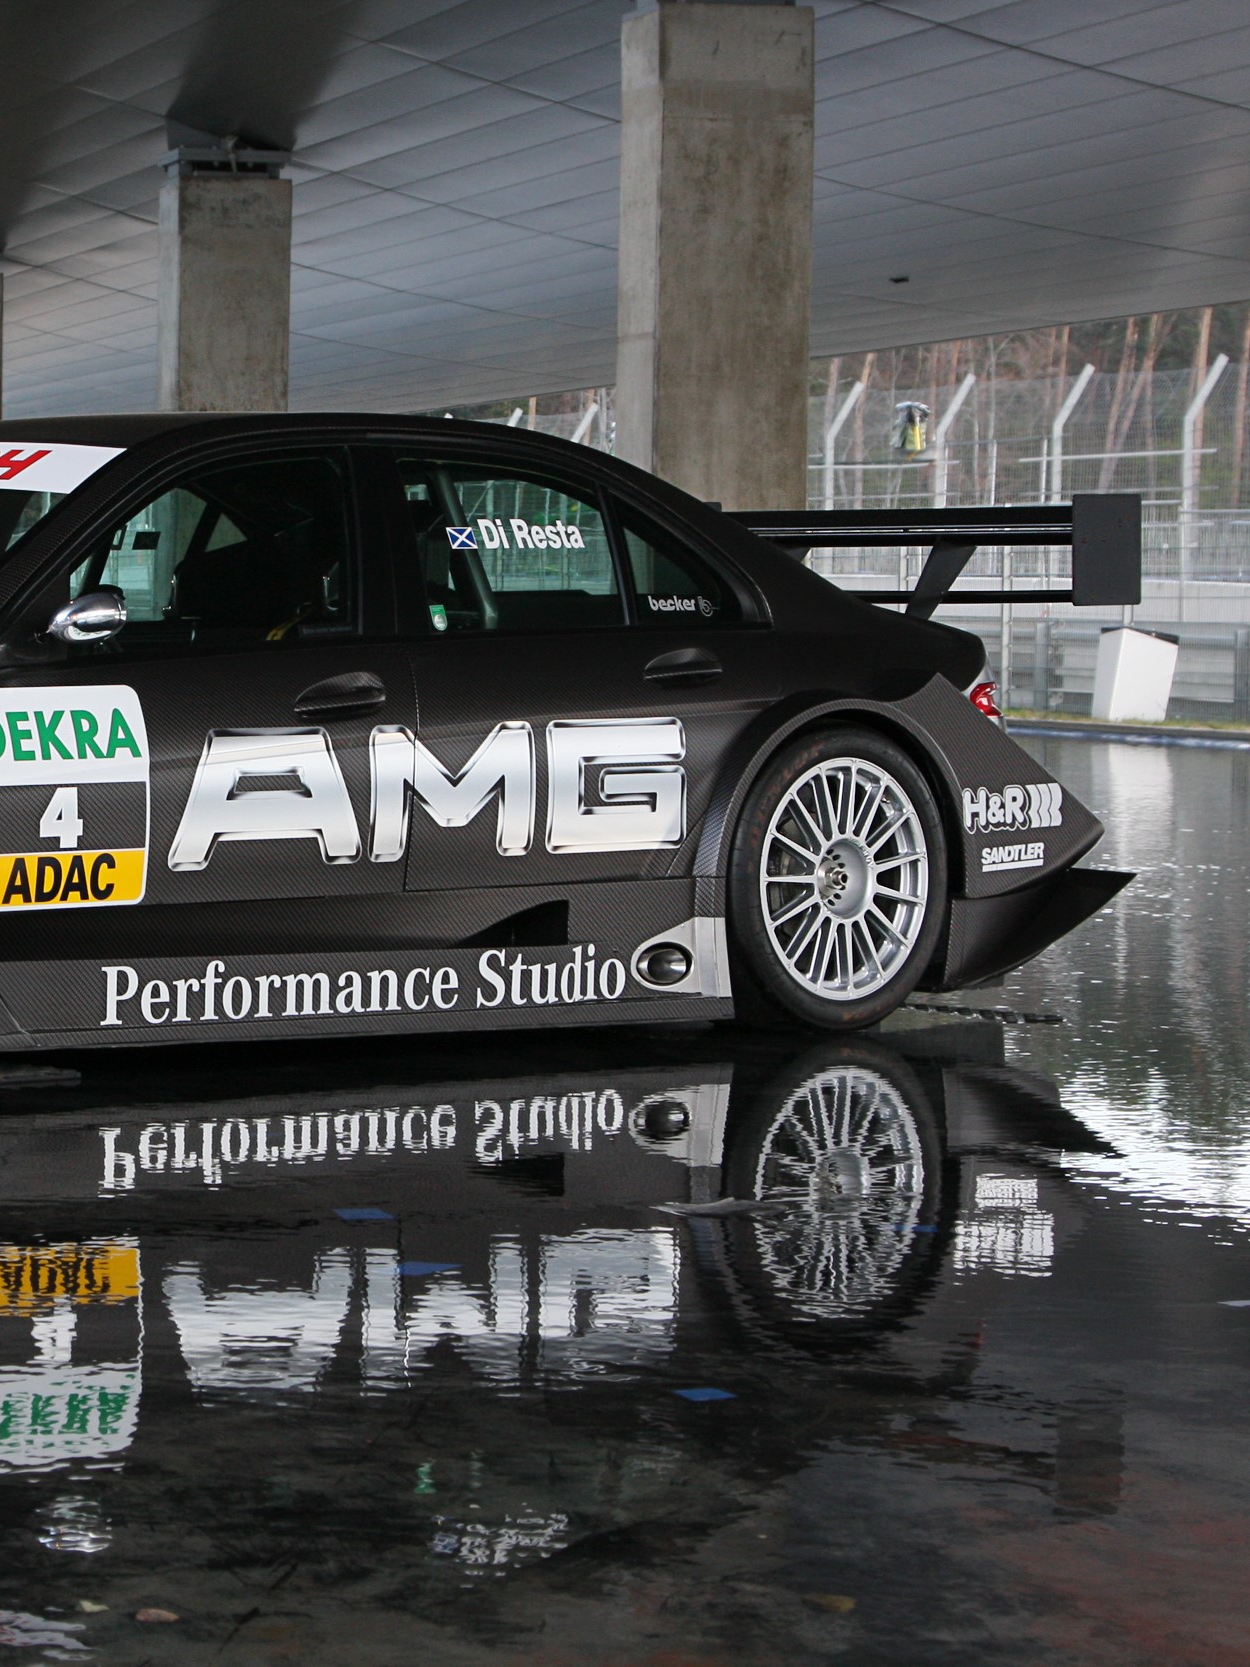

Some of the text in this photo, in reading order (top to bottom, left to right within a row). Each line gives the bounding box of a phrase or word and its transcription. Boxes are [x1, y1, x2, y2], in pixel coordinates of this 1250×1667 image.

[477, 518, 585, 549] Di Resta
[648, 595, 696, 611] becker
[40, 787, 83, 848] 4
[168, 717, 686, 871] AMG
[963, 785, 1029, 834] H&R
[981, 842, 1044, 864] SANDTLER
[2, 853, 116, 904] ADAC
[100, 943, 626, 1026] Performance Studio
